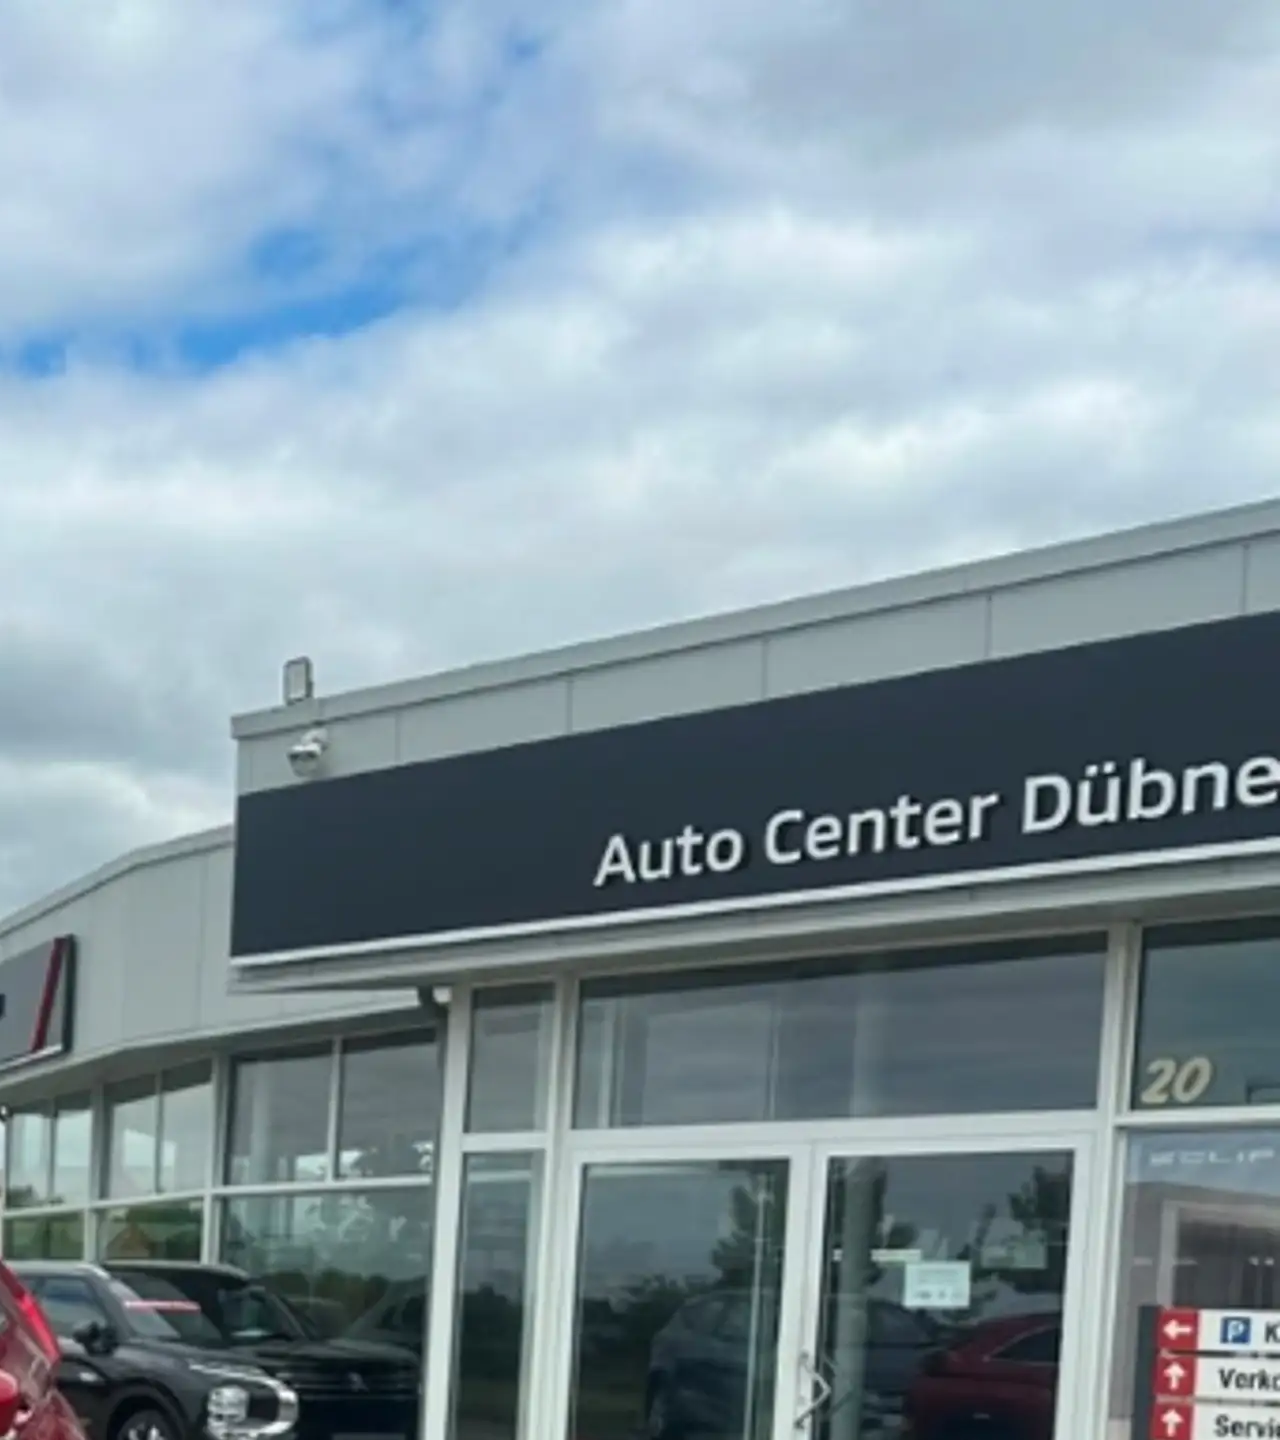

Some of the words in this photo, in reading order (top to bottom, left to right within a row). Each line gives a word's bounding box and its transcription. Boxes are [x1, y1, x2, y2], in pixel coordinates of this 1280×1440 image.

[593, 825, 743, 887] Auto
[764, 791, 999, 865] Center
[1021, 754, 1280, 834] Dübne
[1142, 1056, 1213, 1105] 20
